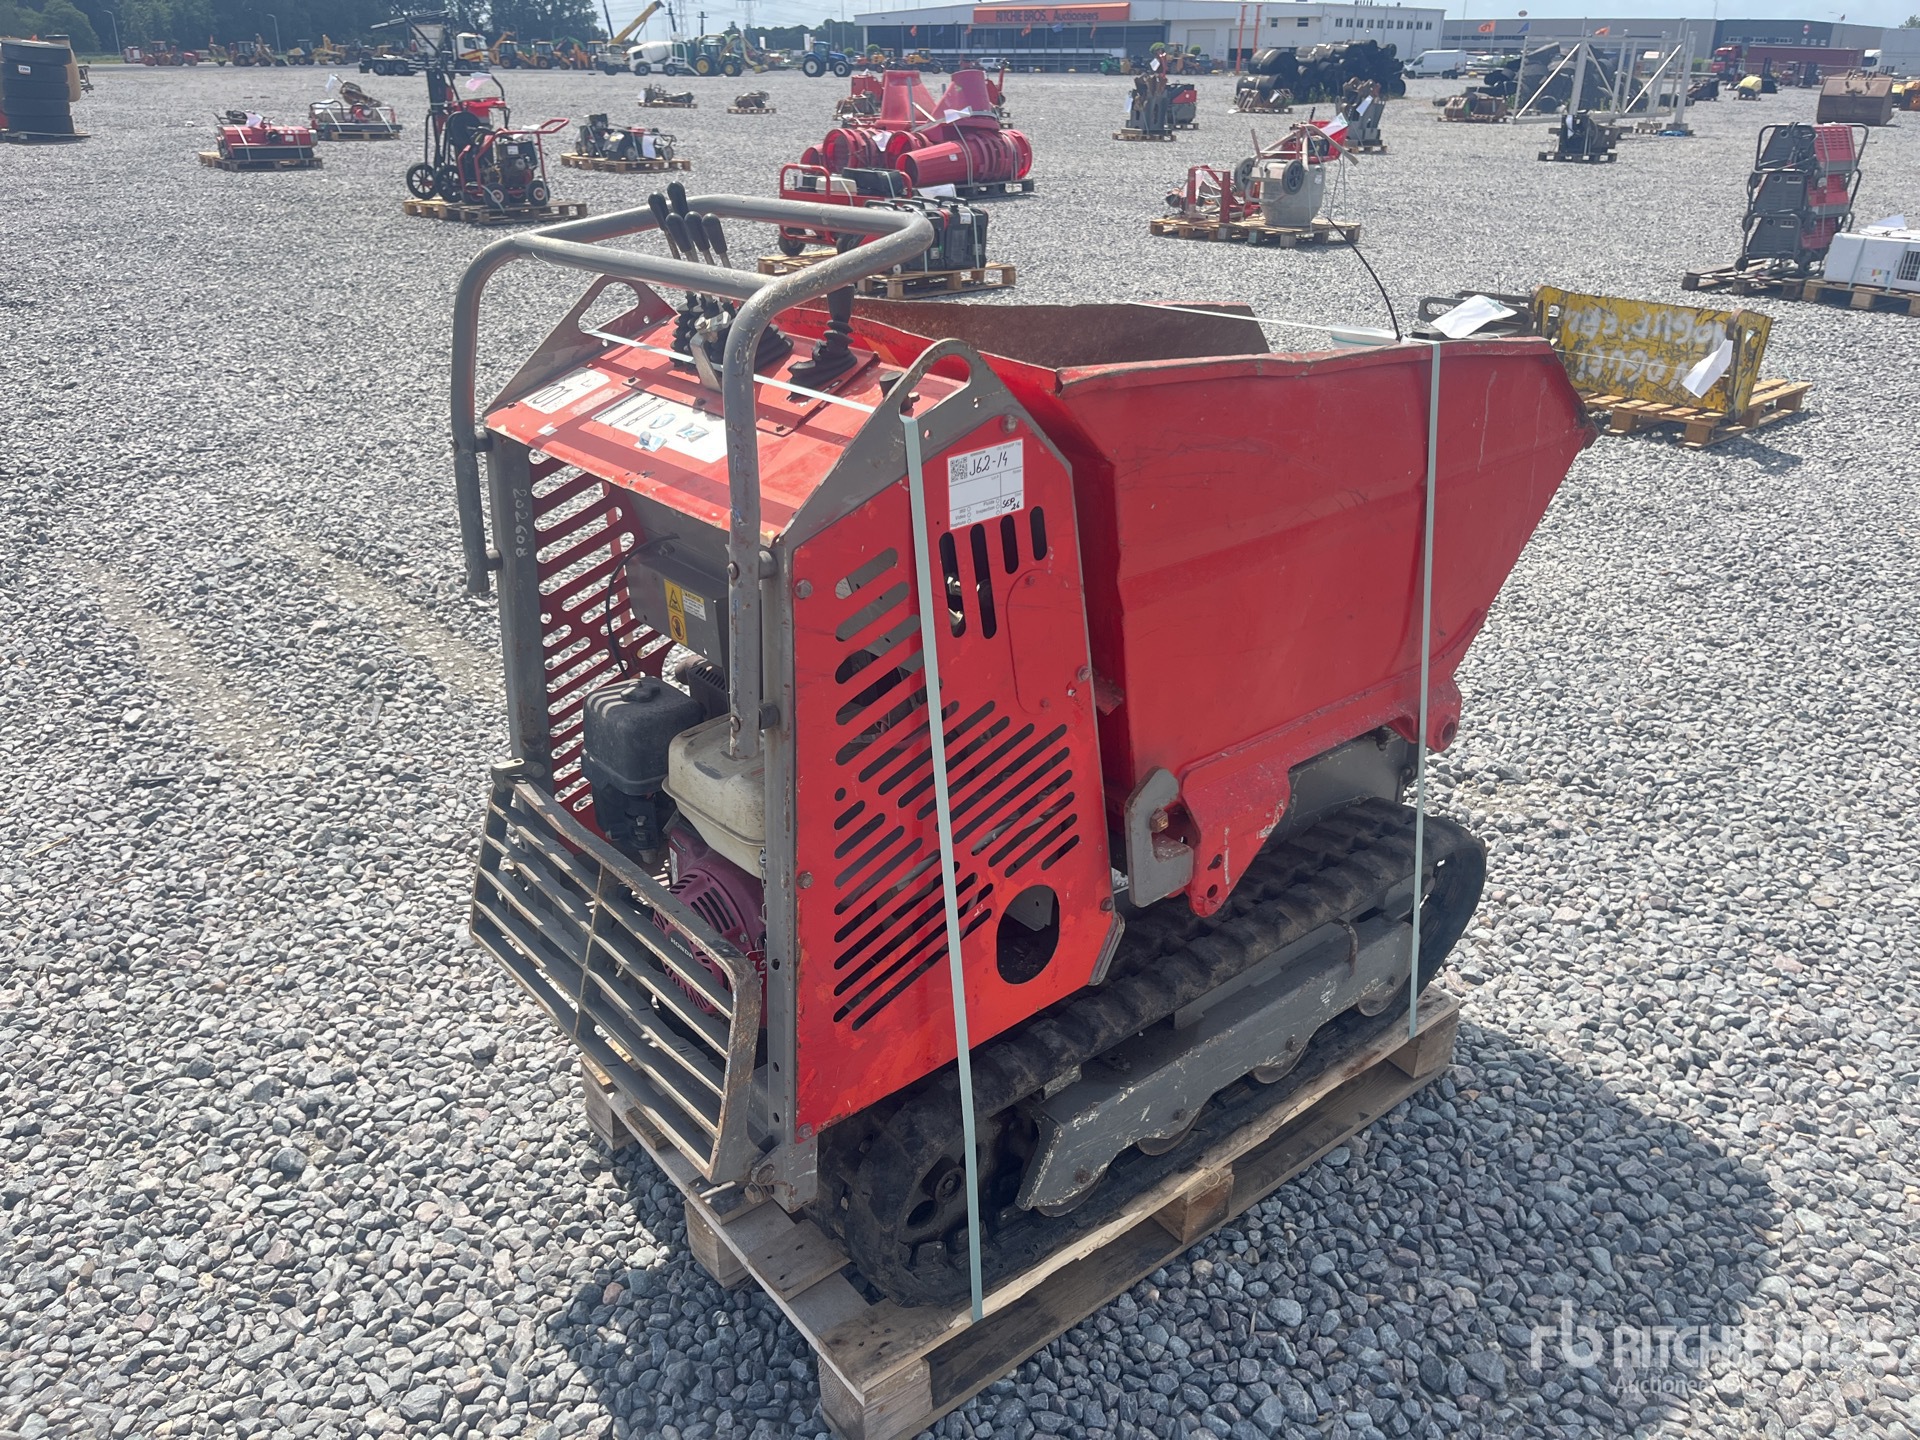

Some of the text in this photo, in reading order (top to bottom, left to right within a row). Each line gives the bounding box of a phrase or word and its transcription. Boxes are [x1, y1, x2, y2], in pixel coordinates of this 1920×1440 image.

[995, 9, 1023, 22] RITCHIE
[1053, 8, 1099, 21] Auctioneers
[969, 451, 1008, 476] J62-14
[513, 488, 528, 558] 202608
[670, 937, 694, 960] HONDA
